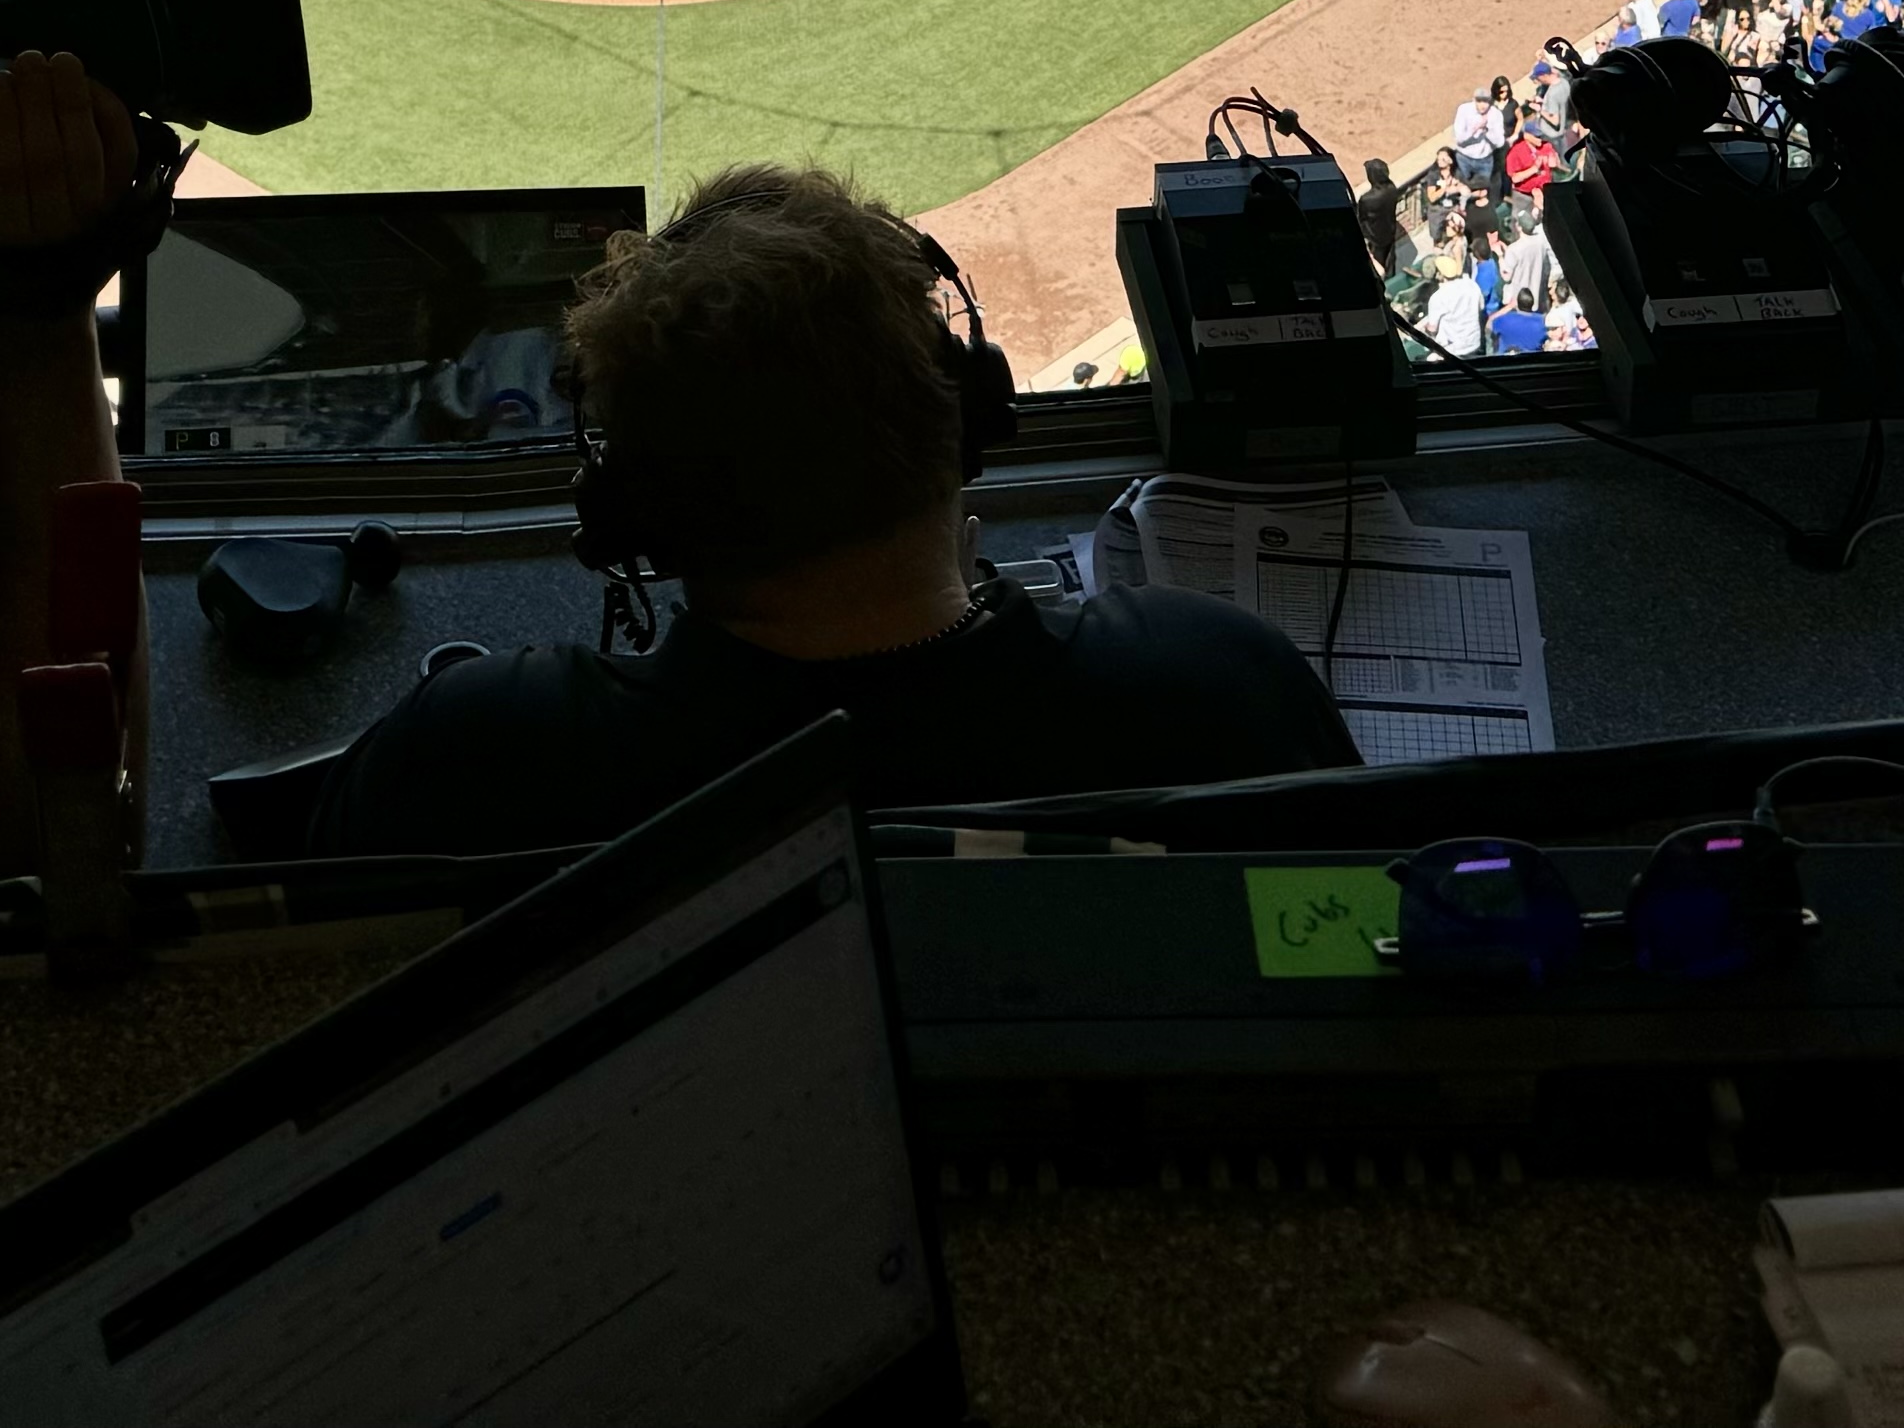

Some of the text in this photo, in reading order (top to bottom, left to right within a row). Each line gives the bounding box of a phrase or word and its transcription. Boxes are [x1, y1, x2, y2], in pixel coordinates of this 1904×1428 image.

[1756, 296, 1796, 307] TALK
[1667, 306, 1718, 321] Cough
[1760, 307, 1804, 319] BACK
[1279, 894, 1350, 947] Cubs
